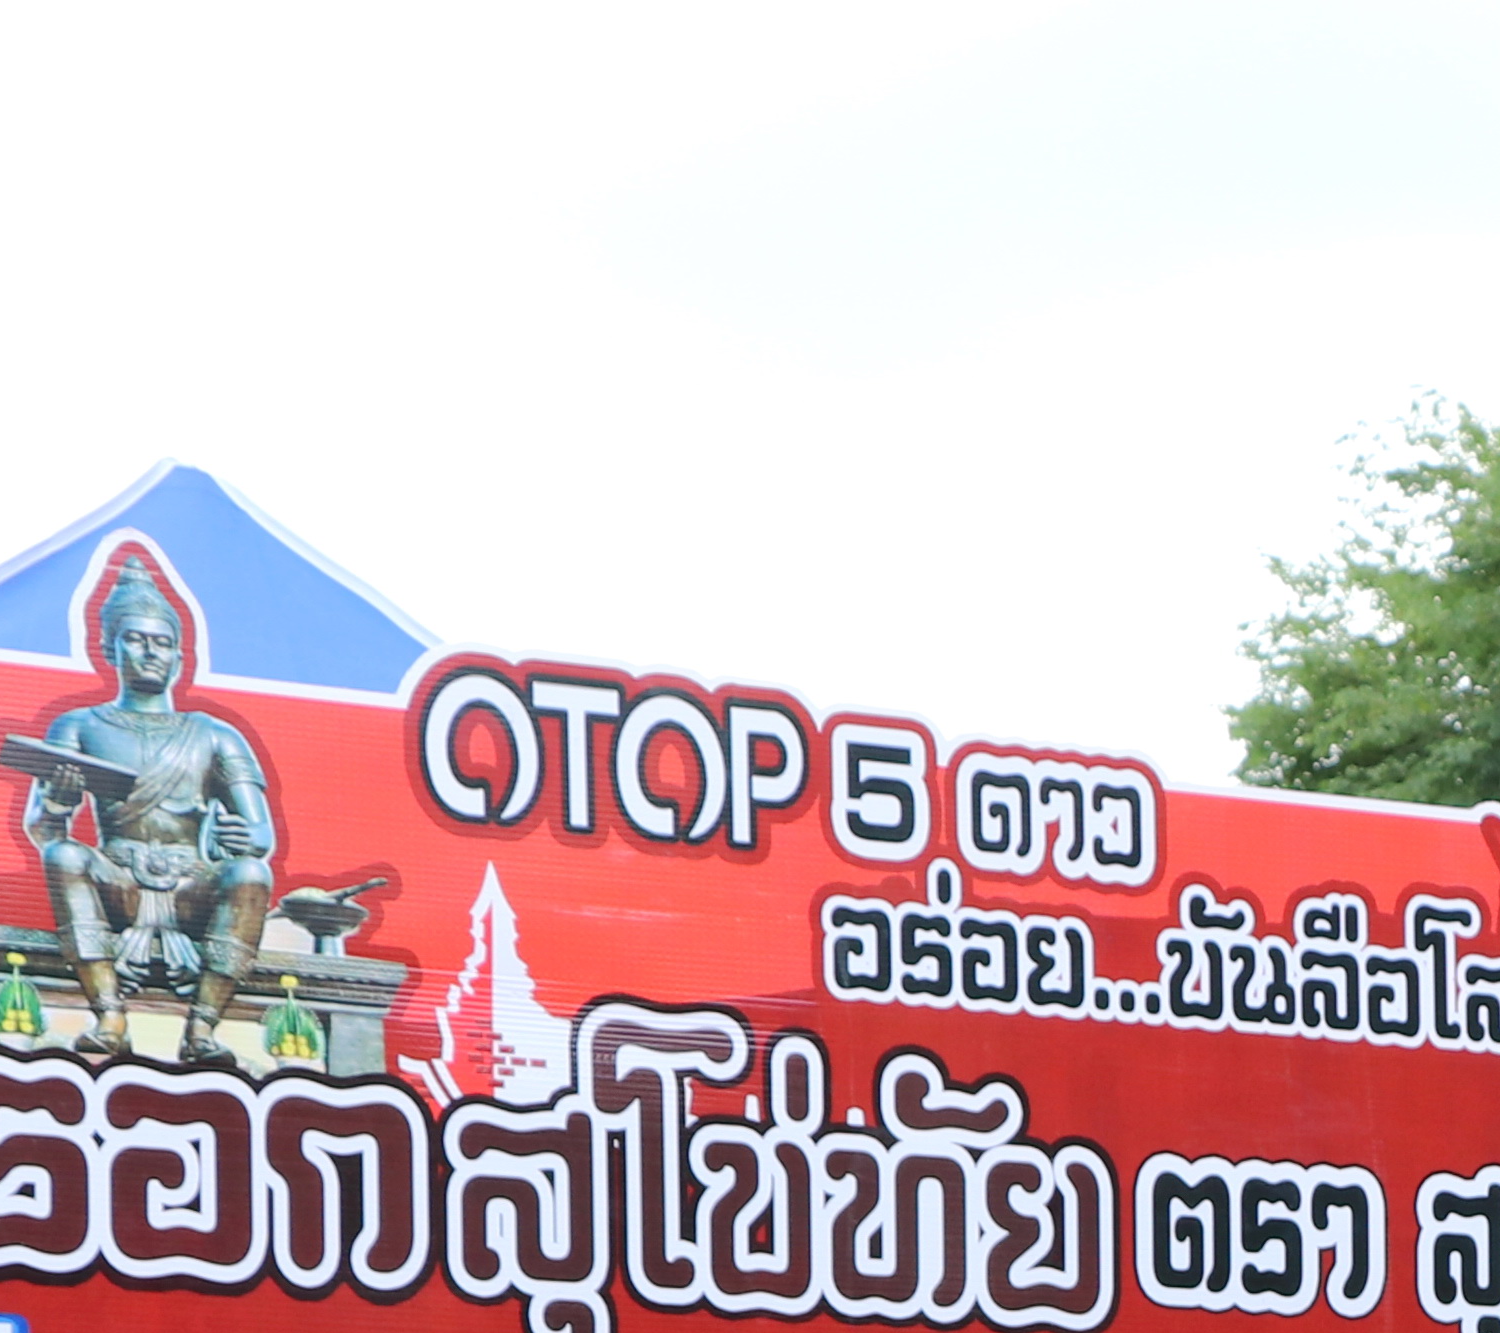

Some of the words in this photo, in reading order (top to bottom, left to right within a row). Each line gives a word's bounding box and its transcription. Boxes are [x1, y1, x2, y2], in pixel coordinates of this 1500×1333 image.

[421, 662, 808, 850] OTOP
[830, 722, 928, 860] 5
[957, 757, 1158, 886] ดาว
[1135, 1150, 1386, 1317] ตรา
